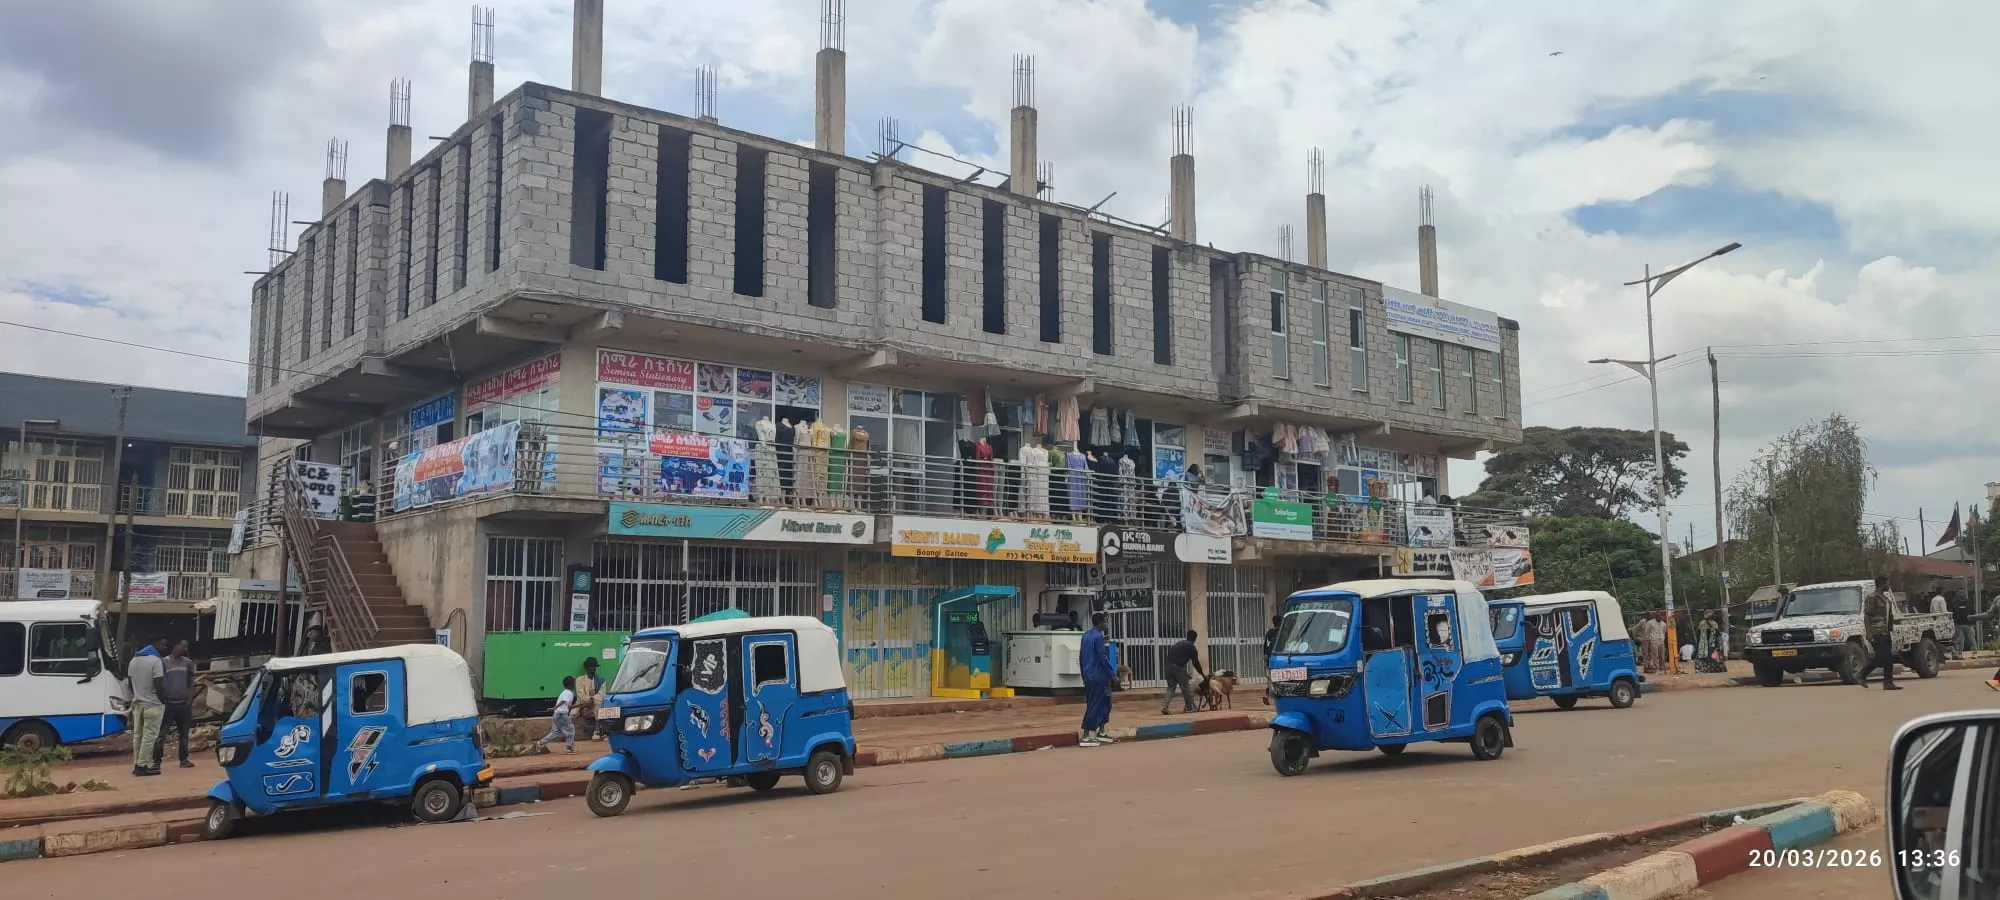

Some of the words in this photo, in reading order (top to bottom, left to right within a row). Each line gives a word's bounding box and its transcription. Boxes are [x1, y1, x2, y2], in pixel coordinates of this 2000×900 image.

[816, 522, 843, 534] Bank
[1146, 543, 1166, 552] BANK
[1072, 554, 1094, 562] Branch
